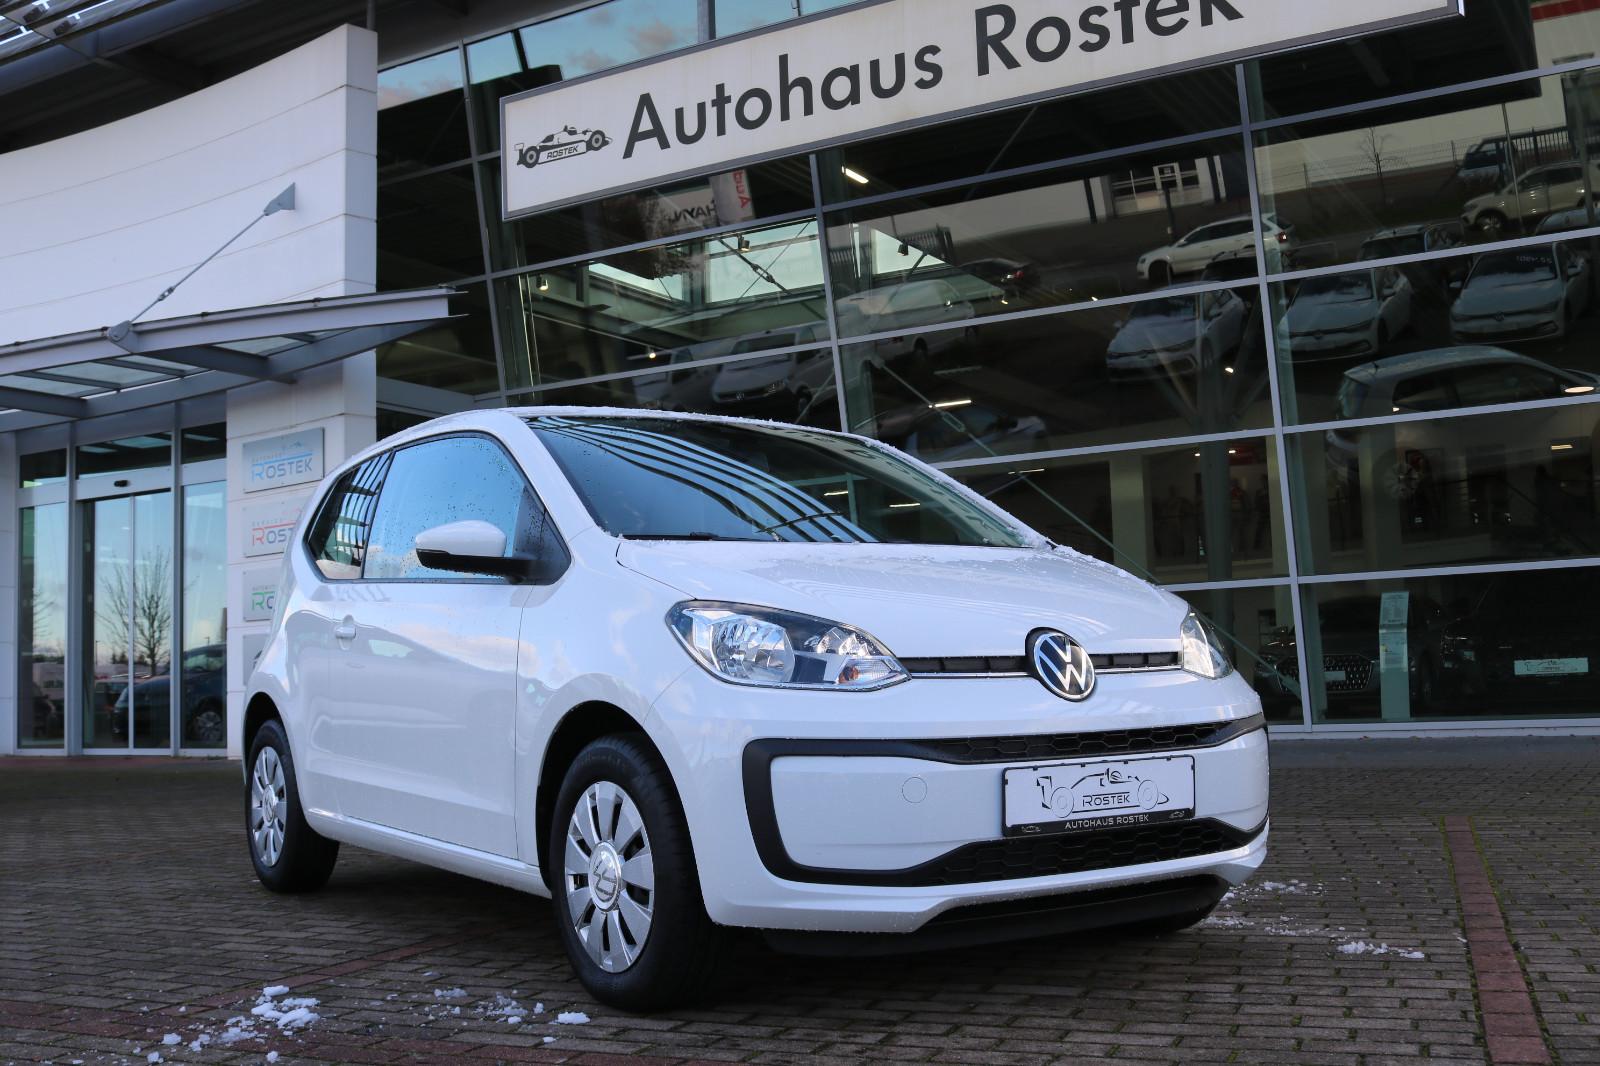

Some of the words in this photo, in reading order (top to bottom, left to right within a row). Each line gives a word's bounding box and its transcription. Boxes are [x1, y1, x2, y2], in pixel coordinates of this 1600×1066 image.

[622, 44, 943, 159] Autohaus
[546, 145, 580, 160] ROSTEK
[251, 457, 313, 482] ROSTEK
[1082, 794, 1130, 807] ROSTEK
[1065, 816, 1114, 829] AUTOHAUS
[1116, 814, 1149, 825] ROSTEK
